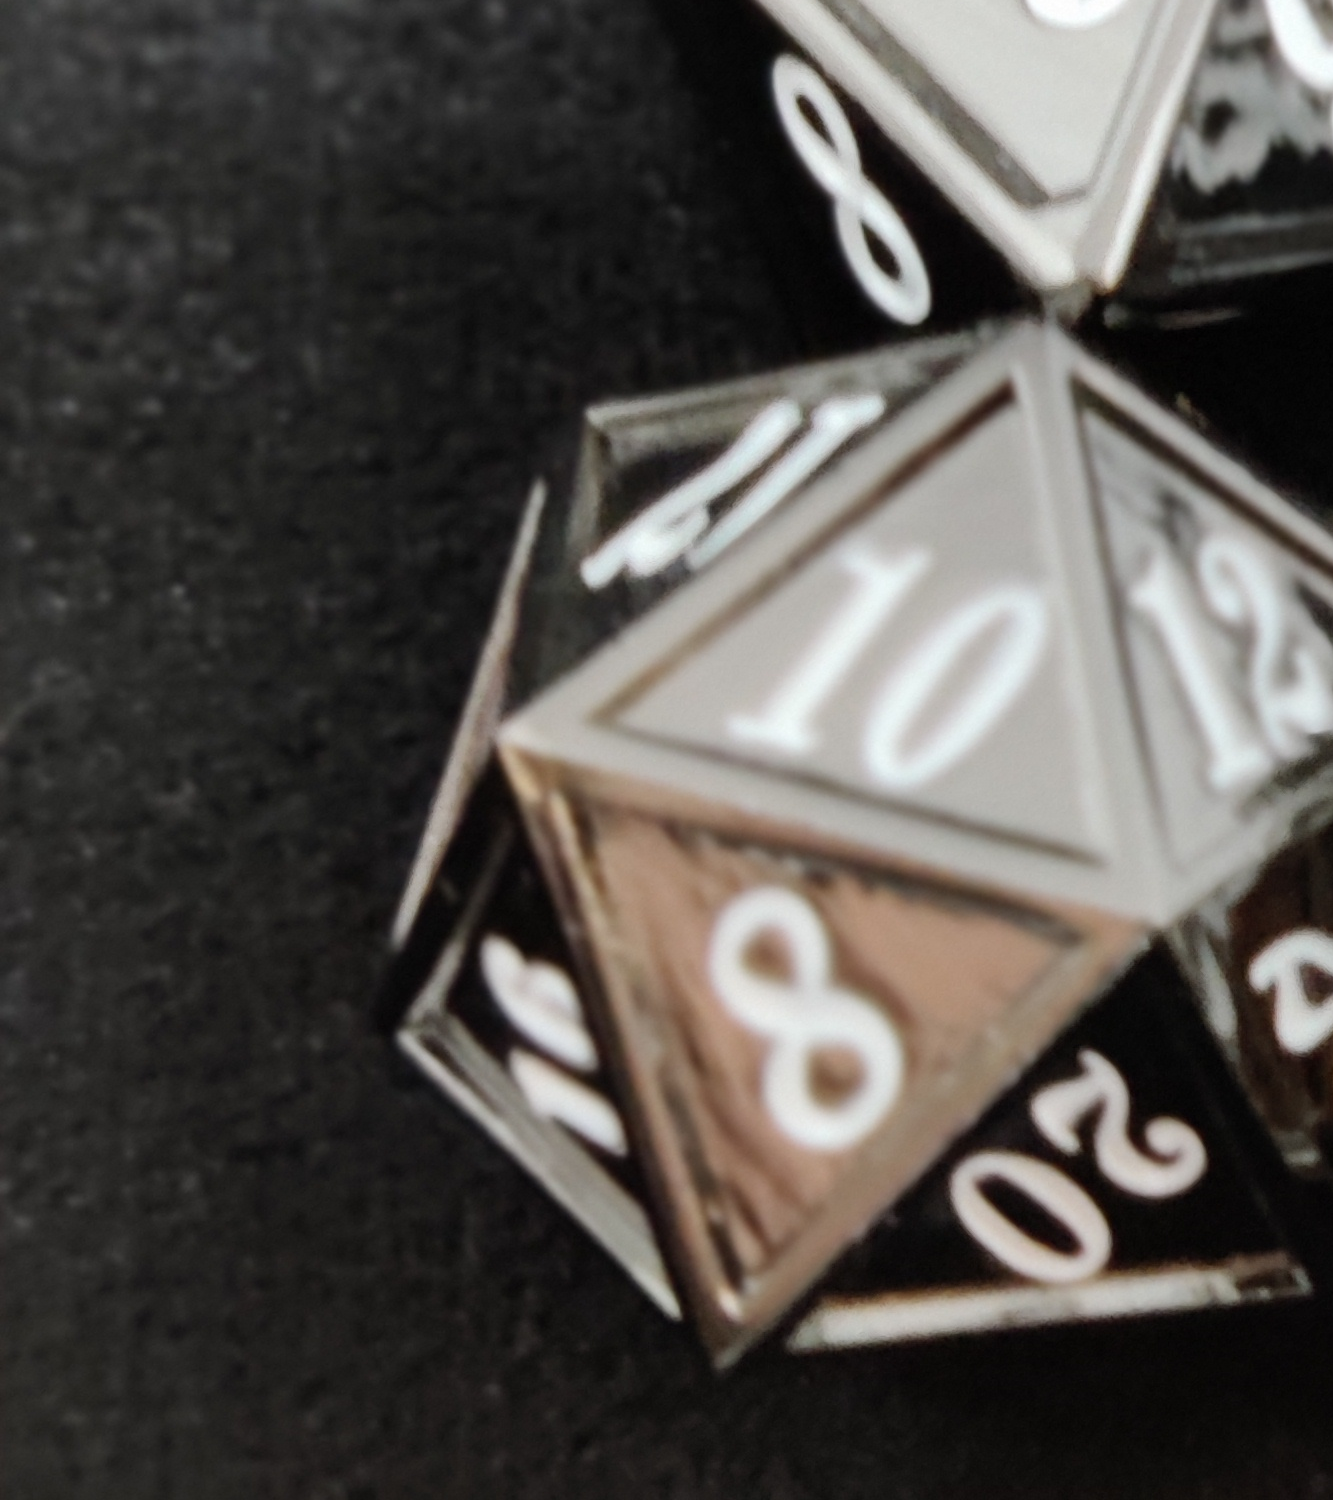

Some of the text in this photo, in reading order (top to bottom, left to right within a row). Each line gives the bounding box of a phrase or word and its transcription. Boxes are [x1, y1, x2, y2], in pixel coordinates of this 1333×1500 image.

[772, 52, 932, 326] 8
[725, 533, 1048, 788] 10
[708, 884, 905, 1154] 8
[949, 1048, 1209, 1286] 20
